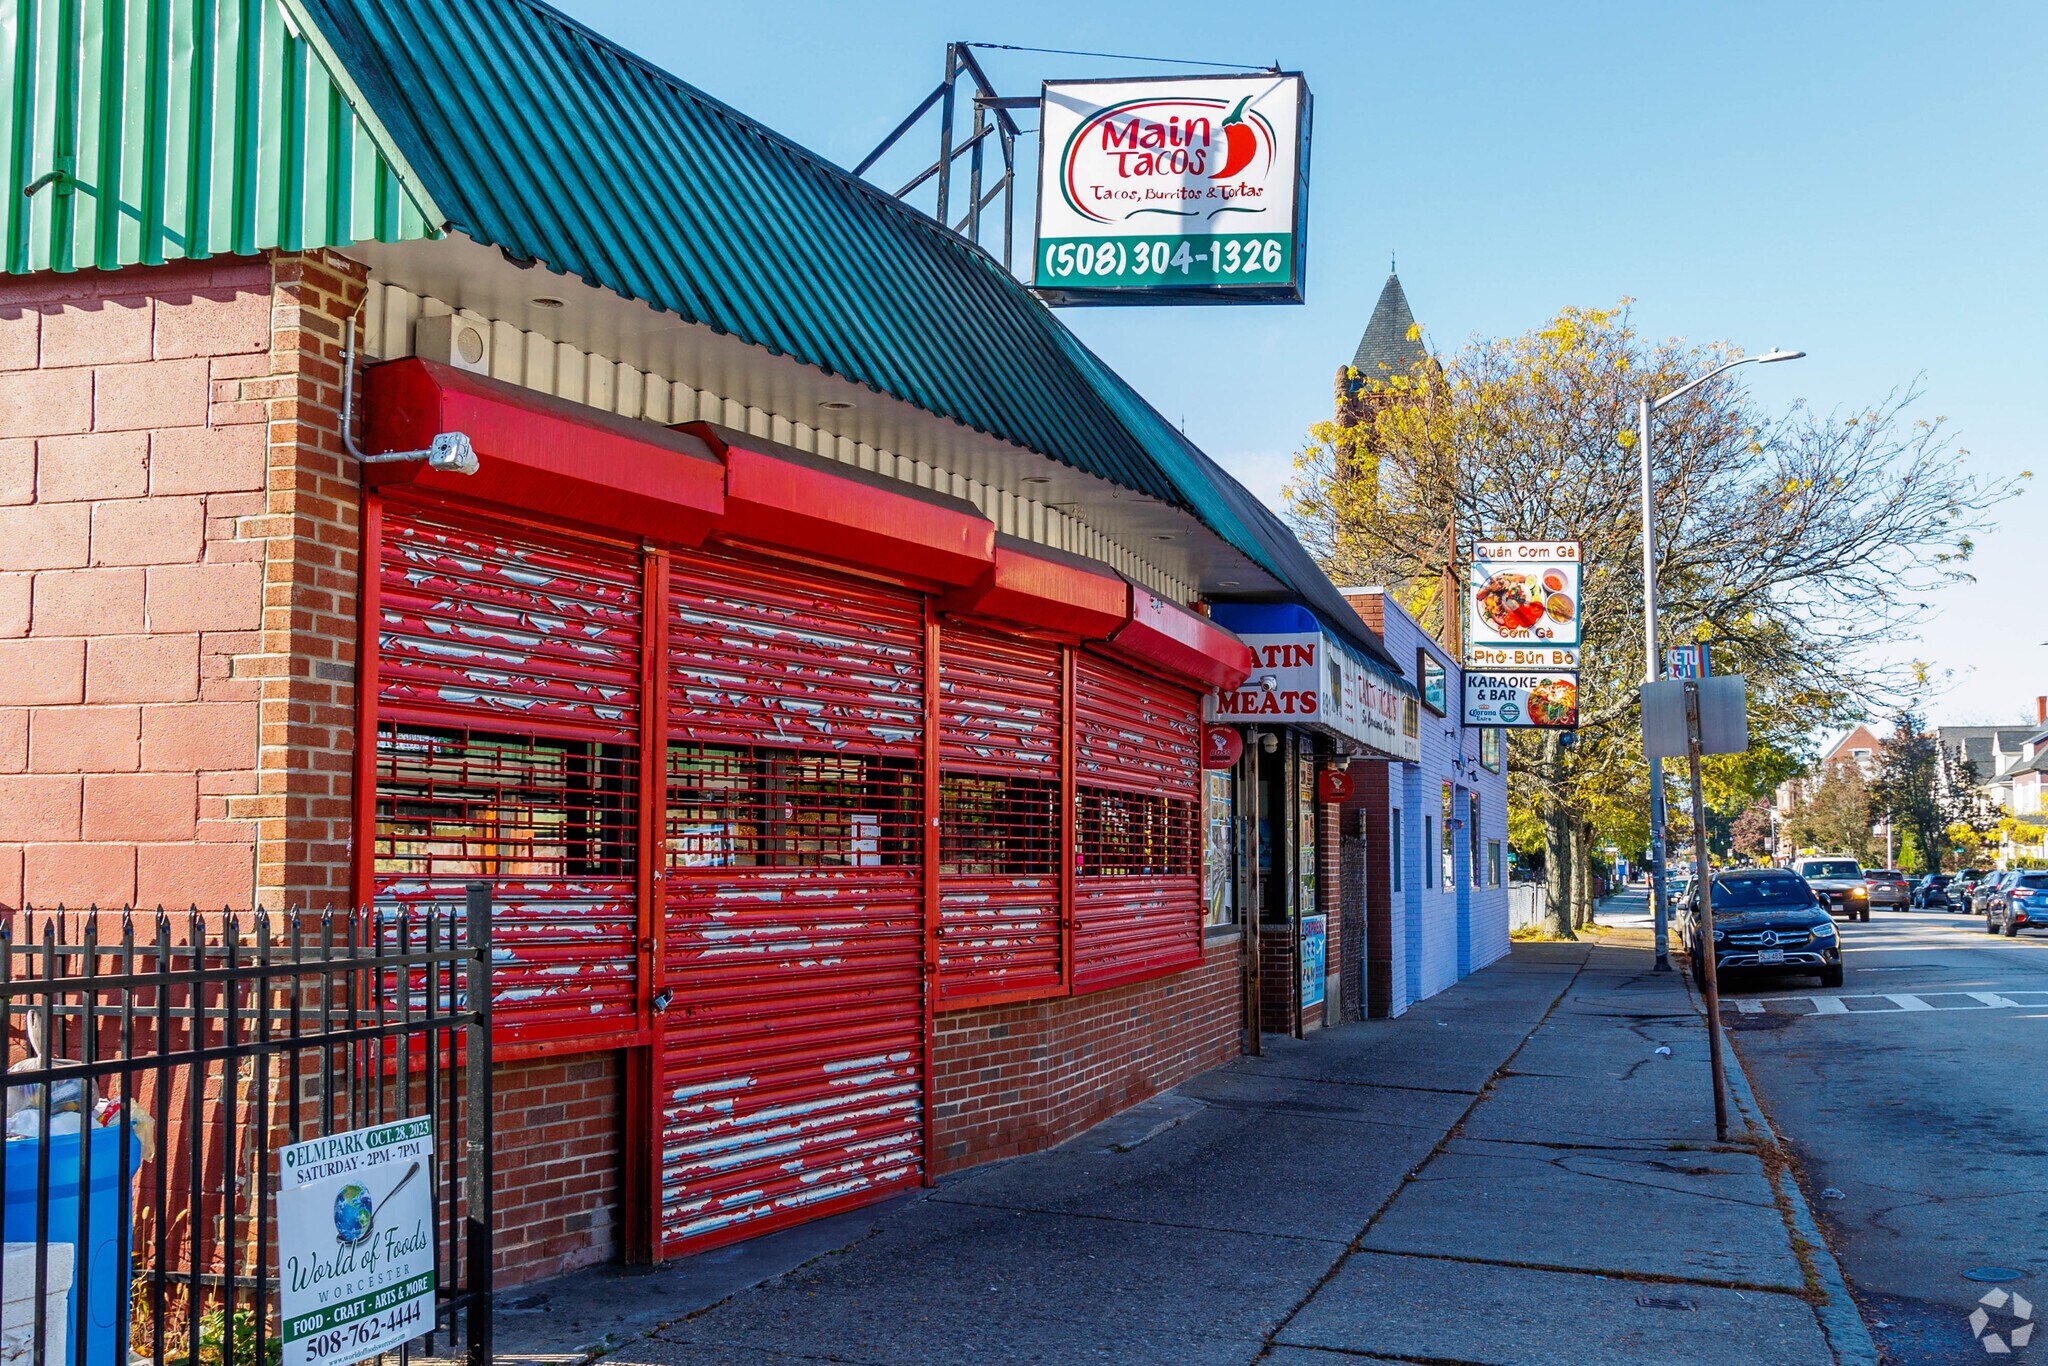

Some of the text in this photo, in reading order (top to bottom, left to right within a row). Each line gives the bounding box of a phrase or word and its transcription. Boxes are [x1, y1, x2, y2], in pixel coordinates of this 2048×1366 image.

[1102, 116, 1210, 150] Main
[1106, 149, 1206, 178] Tacos
[1090, 181, 1263, 202] Tacos, Burritos & Tortas
[1046, 239, 1282, 277] (508) 304-1326
[1477, 545, 1575, 558] Quán Cơm Gà
[1535, 627, 1554, 639] Gà
[1248, 644, 1316, 668] ATIN
[1552, 650, 1574, 665] Bò
[1468, 676, 1537, 688] KARAOKE
[1477, 690, 1516, 700] & BAR
[1217, 691, 1317, 714] MEATS
[1469, 709, 1497, 717] Corona
[370, 1121, 429, 1147] OCT. 28, 2023
[296, 1133, 364, 1166] ELM PARK
[297, 1156, 359, 1184] SATURDAY
[367, 1149, 390, 1166] 2PM
[398, 1142, 420, 1158] 7PM
[287, 1219, 428, 1293] World of Foods
[318, 1264, 410, 1303] WORCESTER
[293, 1314, 324, 1336] FOOD
[333, 1300, 366, 1322] CRAFT
[374, 1289, 396, 1309] ARTS
[397, 1286, 404, 1300] &
[405, 1277, 429, 1297] MORE
[306, 1300, 421, 1362] 508-762-4444
